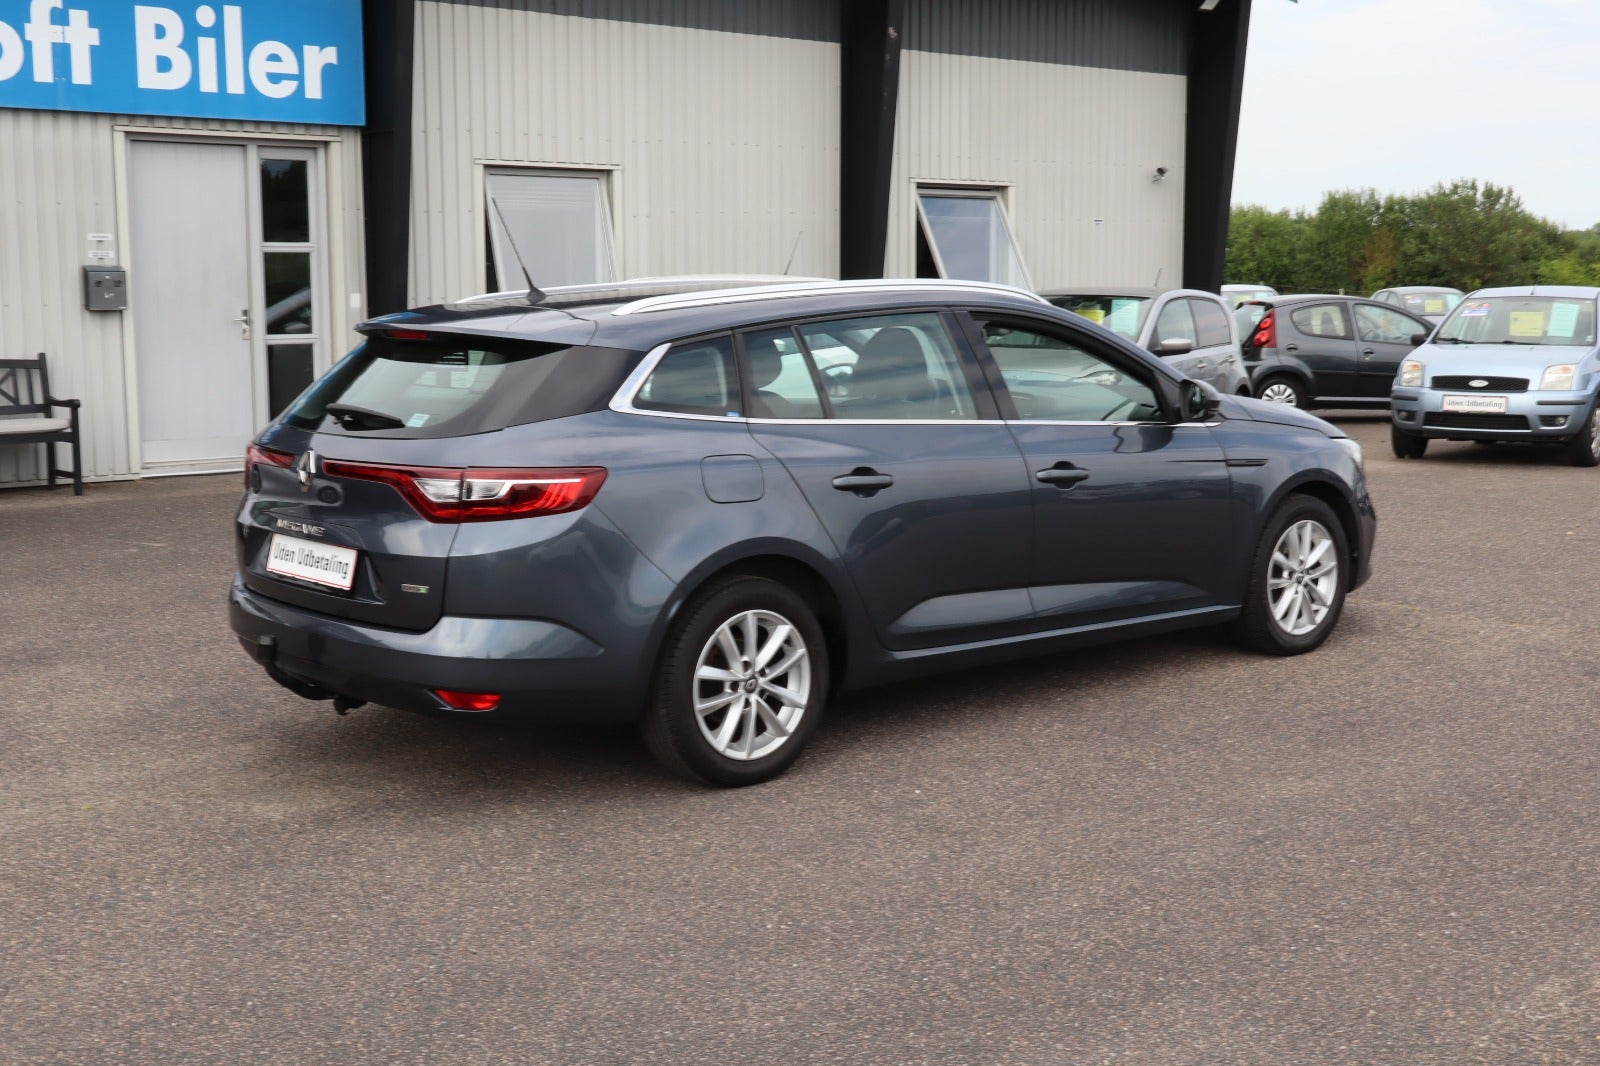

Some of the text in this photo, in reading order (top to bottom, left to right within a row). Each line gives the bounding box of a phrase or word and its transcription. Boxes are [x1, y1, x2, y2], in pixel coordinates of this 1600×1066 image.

[134, 5, 338, 100] Biler
[273, 541, 350, 580] Uden Udbetaling
